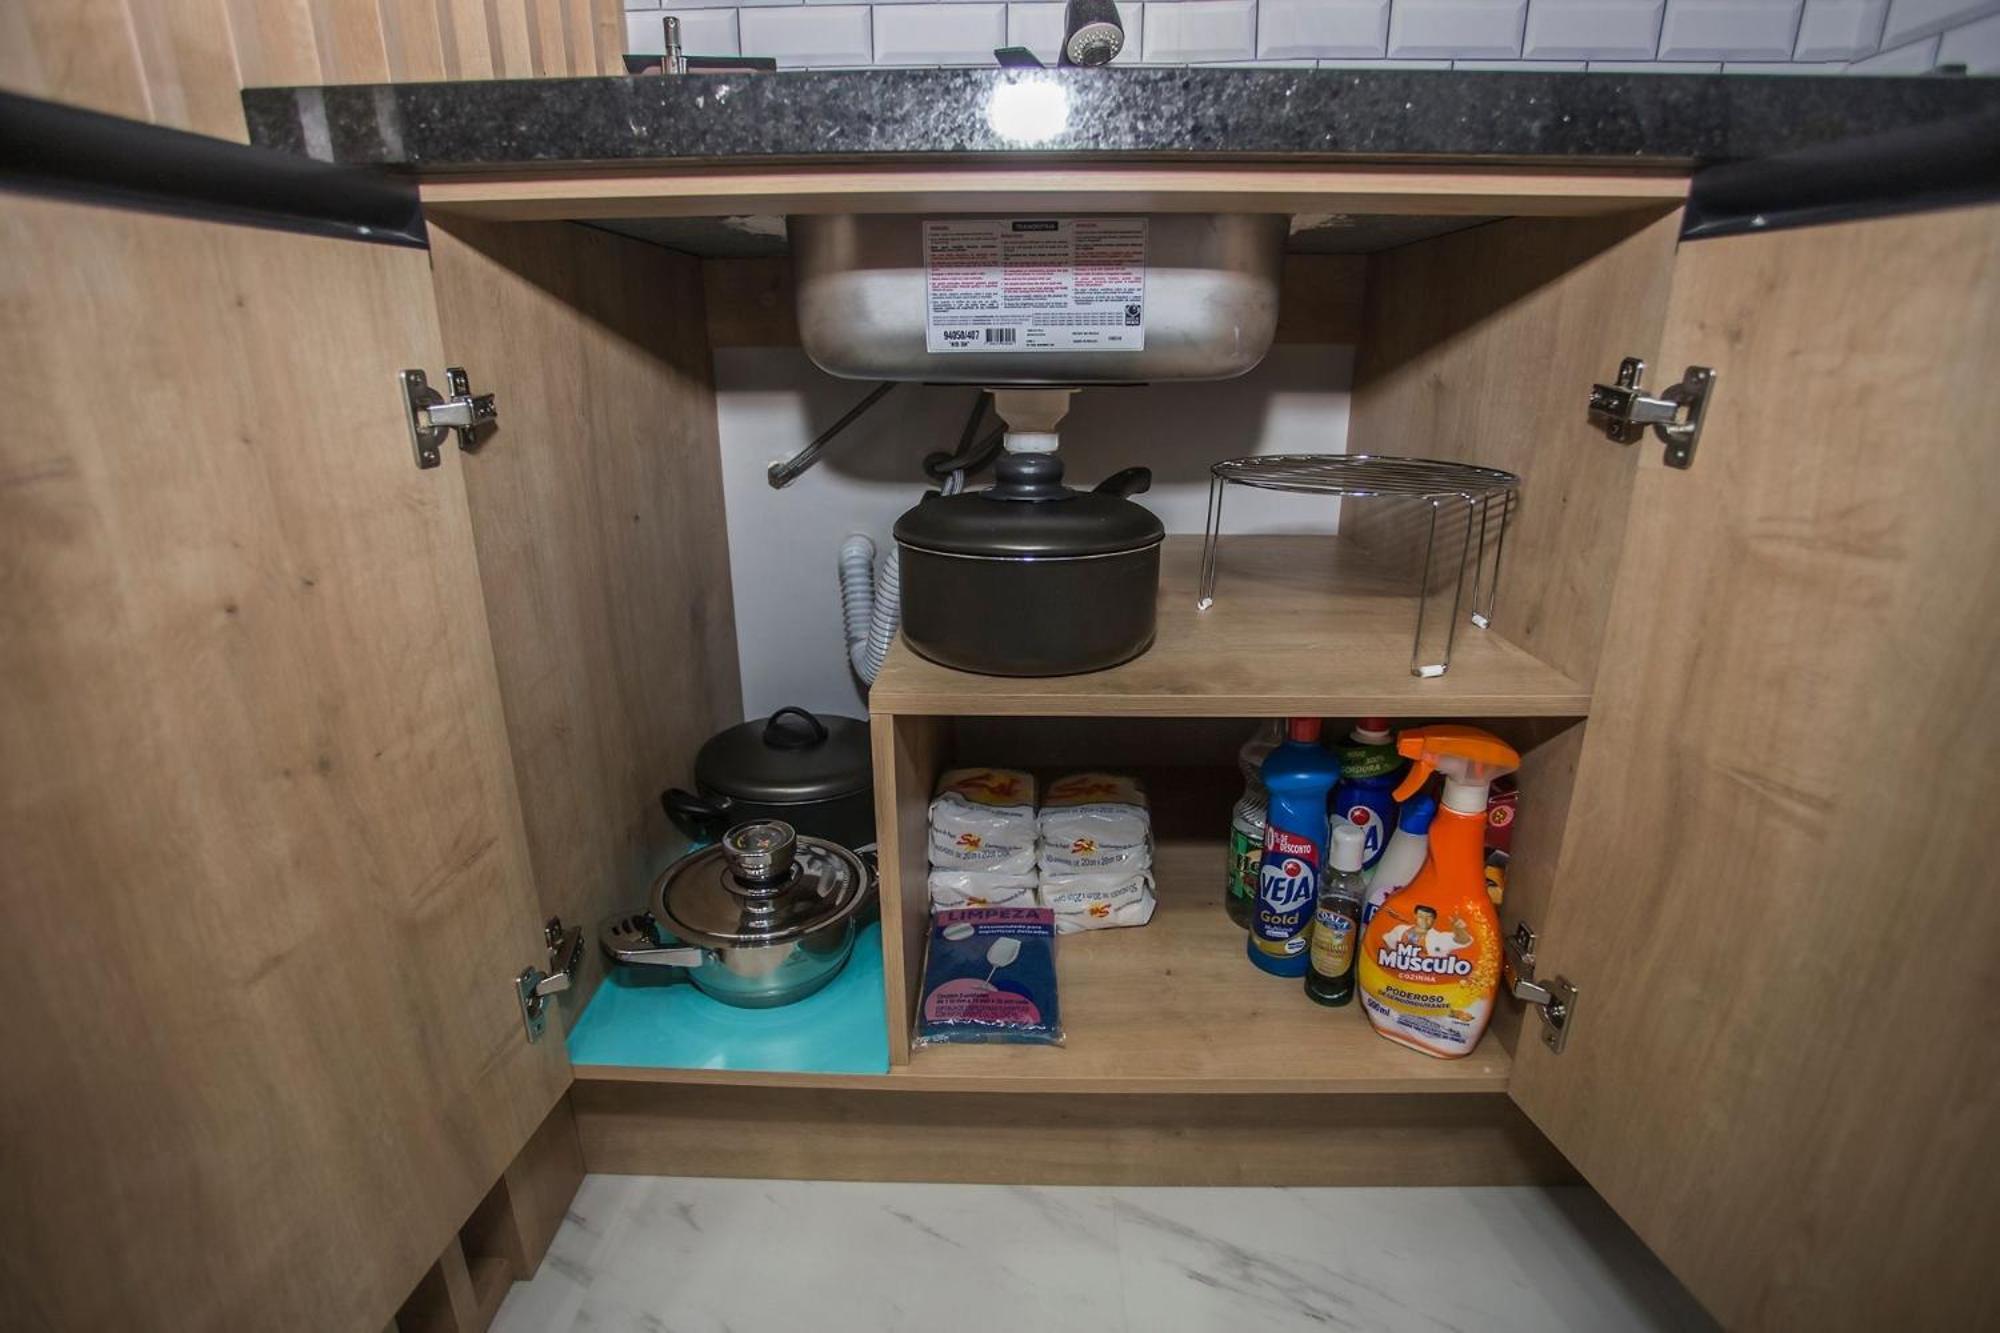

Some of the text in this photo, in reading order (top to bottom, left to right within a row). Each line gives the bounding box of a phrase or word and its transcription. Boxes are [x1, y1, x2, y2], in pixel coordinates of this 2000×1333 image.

[1280, 843, 1311, 854] DESCONTO
[1261, 873, 1310, 906] VEJA
[948, 909, 1040, 921] LIMPEZA
[1260, 910, 1299, 925] Gold
[1397, 943, 1421, 957] Mr
[1399, 973, 1436, 983] COZINHA
[1386, 985, 1444, 1003] PODEROSO
